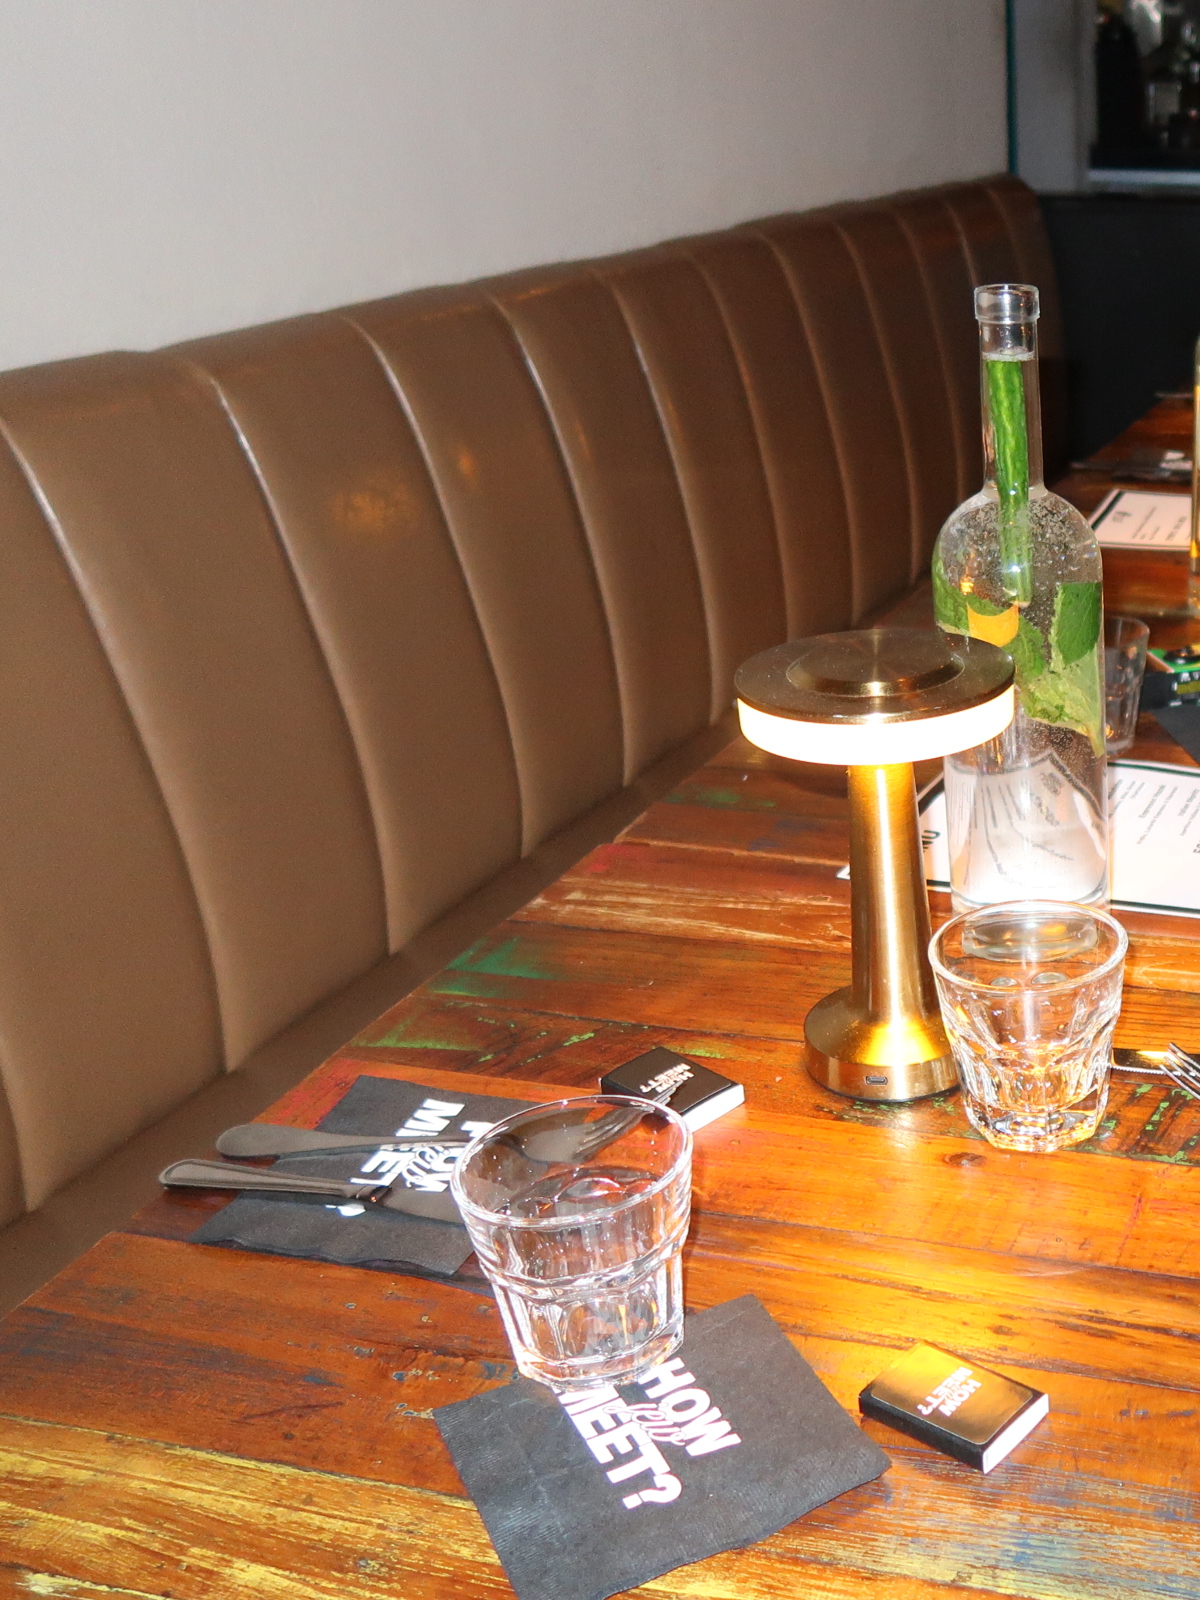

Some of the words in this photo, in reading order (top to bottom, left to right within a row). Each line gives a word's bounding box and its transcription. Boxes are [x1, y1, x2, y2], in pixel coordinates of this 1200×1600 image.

[640, 1063, 691, 1093] MEET?
[638, 1356, 742, 1457] HOW
[916, 1366, 974, 1416] MEET?
[938, 1378, 982, 1417] HOW
